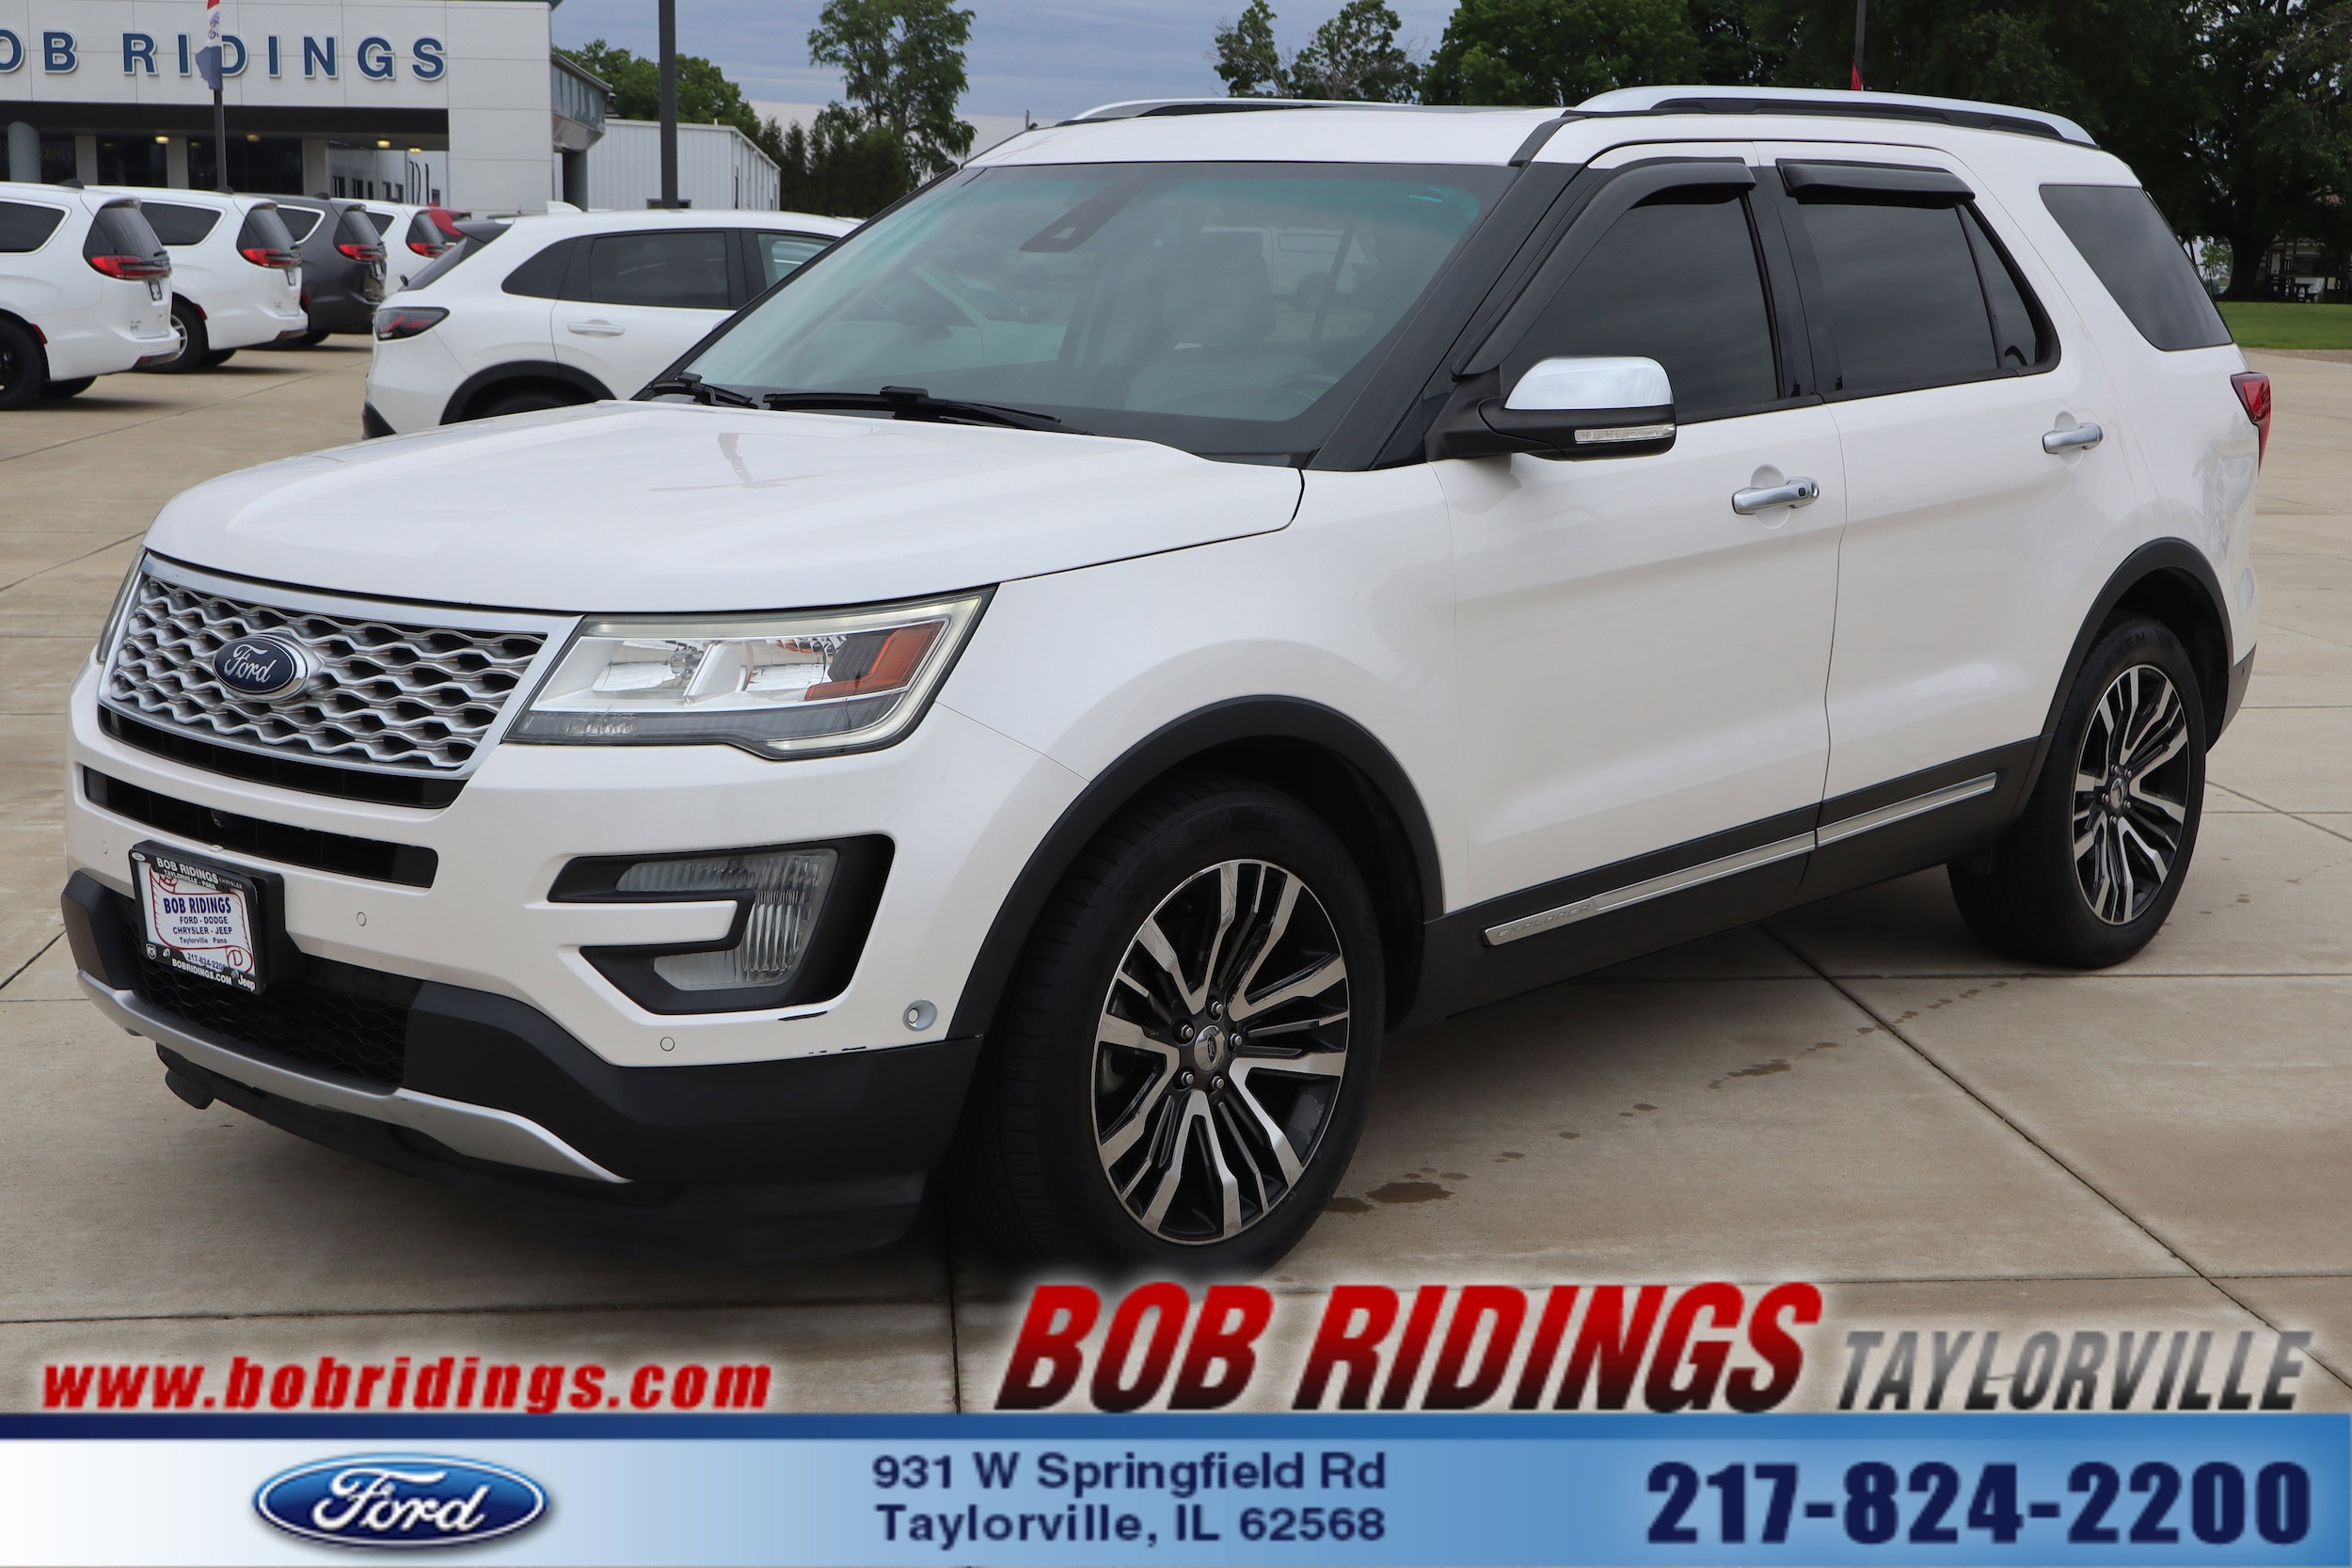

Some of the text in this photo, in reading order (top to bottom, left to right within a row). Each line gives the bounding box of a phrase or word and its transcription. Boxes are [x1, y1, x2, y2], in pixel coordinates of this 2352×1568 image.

[122, 31, 447, 81] RIDINGS
[224, 644, 277, 683] Ford
[156, 857, 218, 884] BOB RIDINGS
[164, 870, 198, 884] TAYLORVILLE
[201, 880, 216, 890] PANA
[218, 878, 243, 889] CHRYSLER
[164, 896, 231, 914] BOB RIDINGS
[180, 916, 199, 925] FORD
[203, 916, 229, 925] DODGE
[1496, 904, 1590, 939] EXPLORER
[172, 927, 209, 935] CHRYSLER
[215, 927, 232, 935] JEEP
[172, 958, 232, 986] BOBRIDINGS.COM
[238, 974, 256, 991] Jeep
